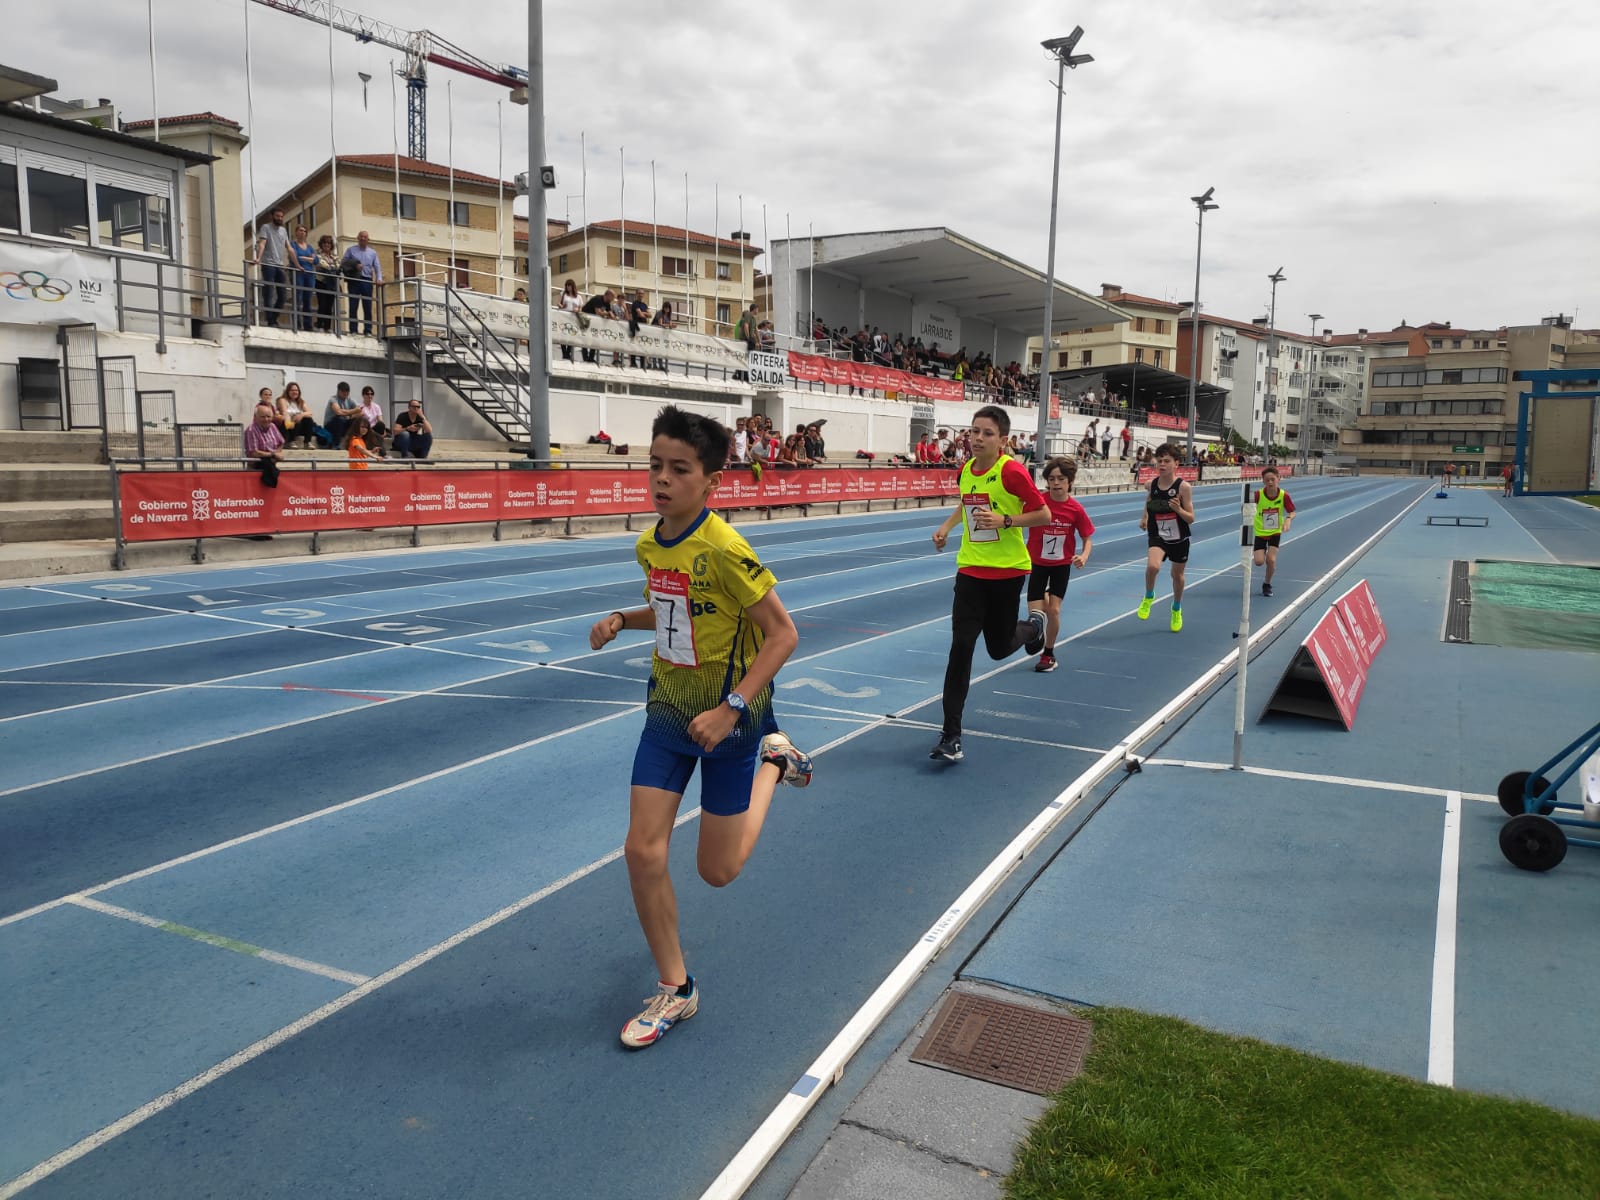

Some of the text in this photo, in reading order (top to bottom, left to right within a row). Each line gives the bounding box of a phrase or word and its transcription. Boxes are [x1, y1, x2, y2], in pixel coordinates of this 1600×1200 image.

[79, 279, 102, 292] NKJ
[750, 352, 785, 369] IRTEERA
[751, 368, 785, 385] SALIDA
[213, 497, 264, 507] Nafarroako
[288, 496, 328, 505] Gobierno
[348, 494, 390, 503] Nafarroako
[410, 493, 441, 501] Gobierno
[139, 500, 188, 510] Gobierno
[348, 505, 386, 514] Gobernua
[404, 503, 442, 511] de Navarra
[214, 510, 259, 520] Gobernua
[282, 507, 328, 516] de Navarra
[130, 513, 188, 523] de Navarra
[1046, 536, 1057, 555] 1
[689, 580, 711, 588] ANA
[655, 596, 679, 650] 7
